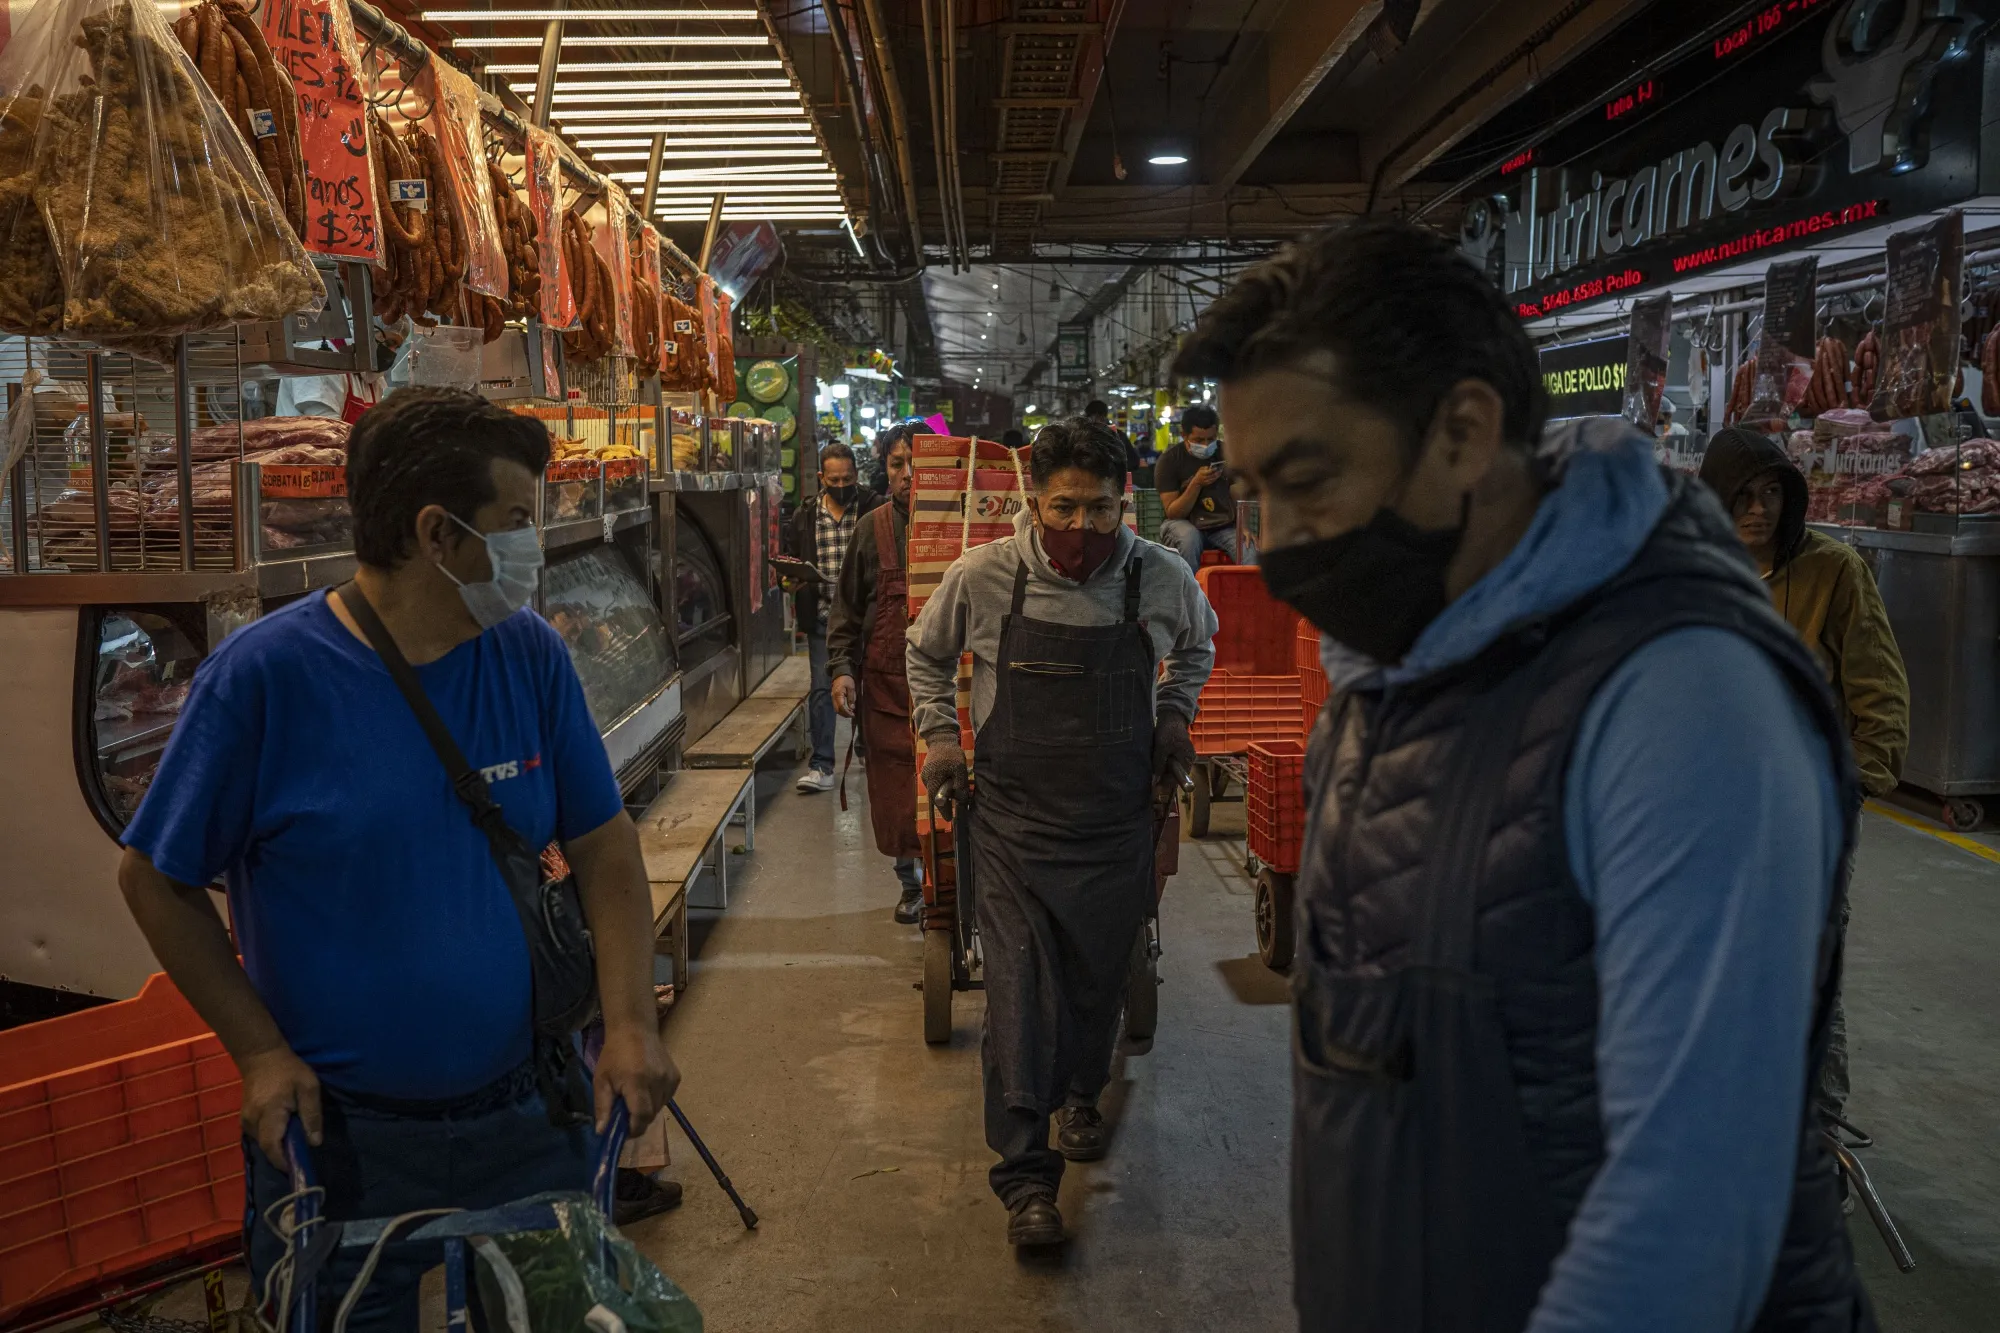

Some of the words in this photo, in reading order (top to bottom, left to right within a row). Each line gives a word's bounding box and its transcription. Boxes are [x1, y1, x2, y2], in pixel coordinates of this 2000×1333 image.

[1713, 20, 1753, 60] Local
[1504, 106, 1788, 295] Nutricarnes
[1672, 200, 1878, 273] www.nutricarnes.mx
[1606, 268, 1642, 293] Pollo
[1564, 369, 1578, 394] DE
[1579, 365, 1612, 392] POLLO
[919, 473, 938, 481] 100%
[915, 545, 935, 553] 100%
